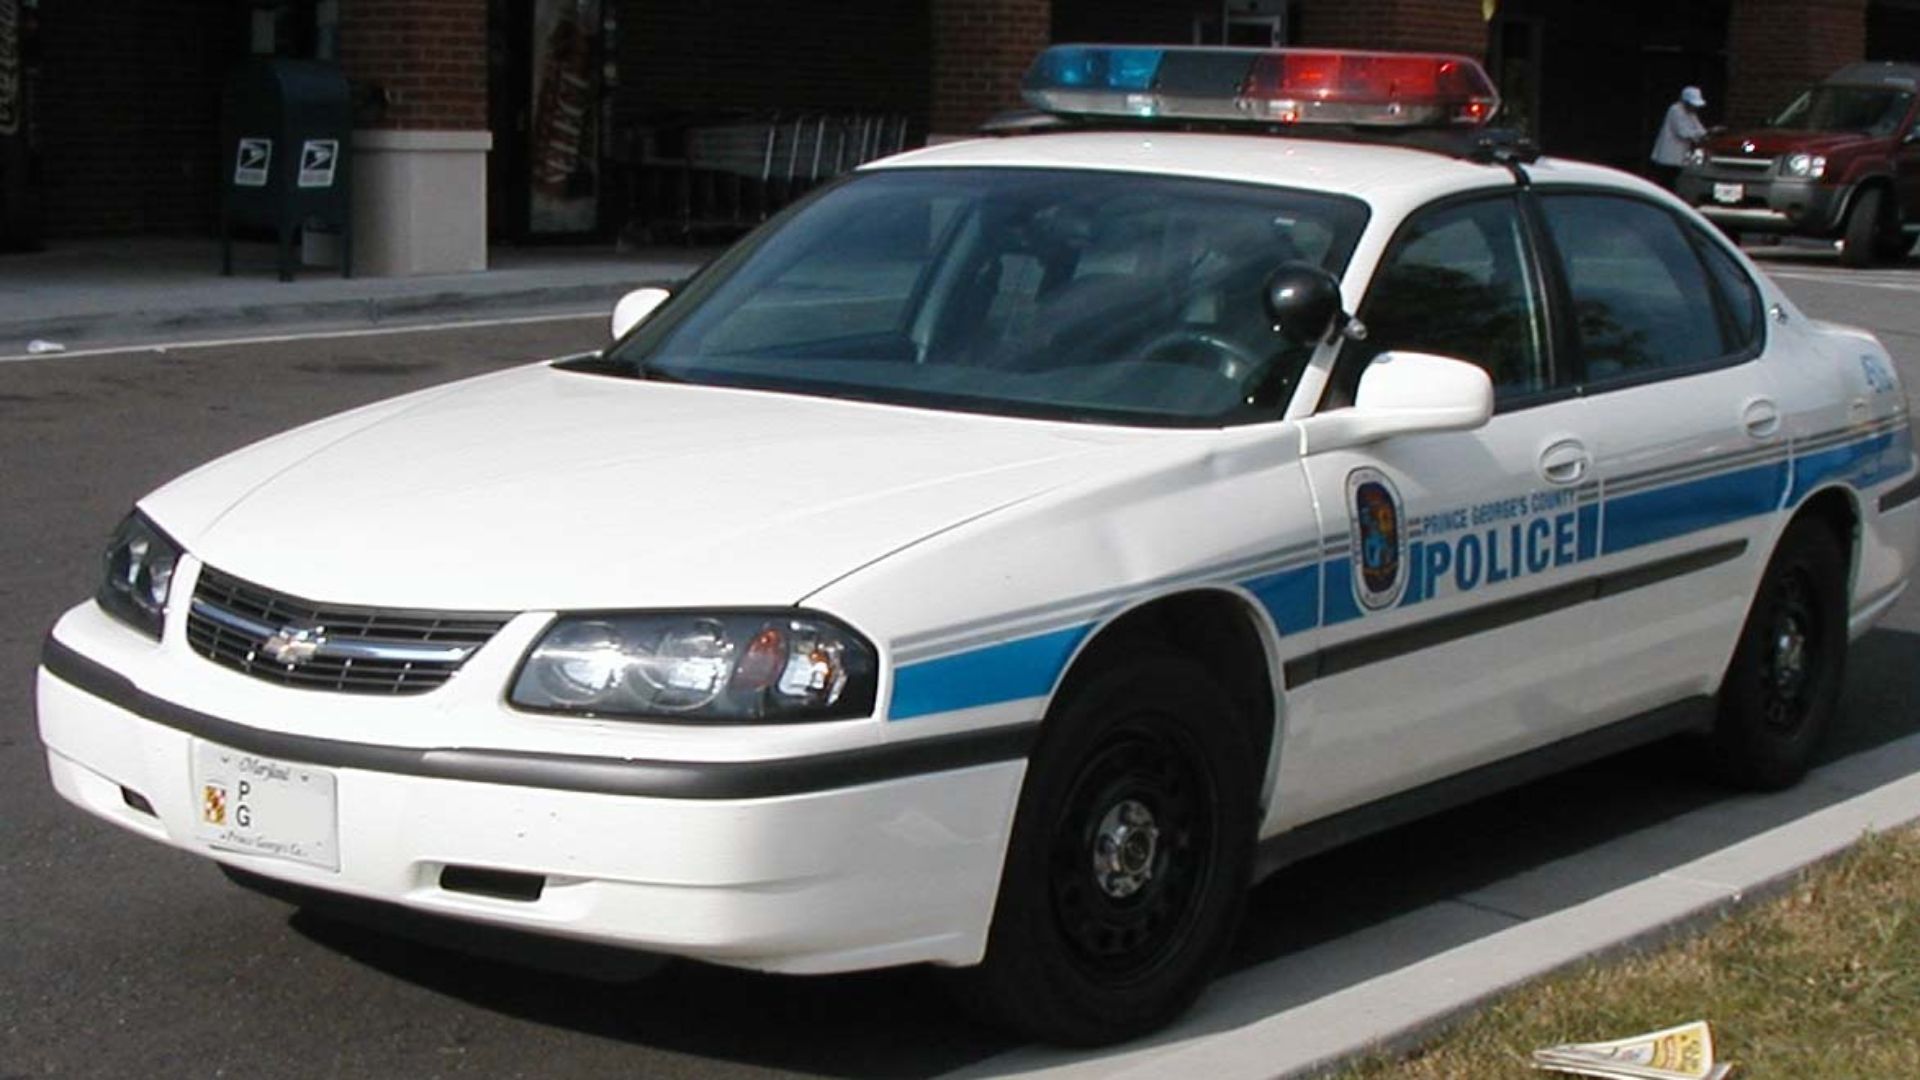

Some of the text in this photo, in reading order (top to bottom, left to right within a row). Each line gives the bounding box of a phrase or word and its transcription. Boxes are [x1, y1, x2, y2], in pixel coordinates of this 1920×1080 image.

[1422, 488, 1575, 534] PRINCE GEORGE'S COUNTY
[1425, 512, 1575, 599] POLICE
[238, 780, 251, 801] P
[236, 805, 250, 827] G
